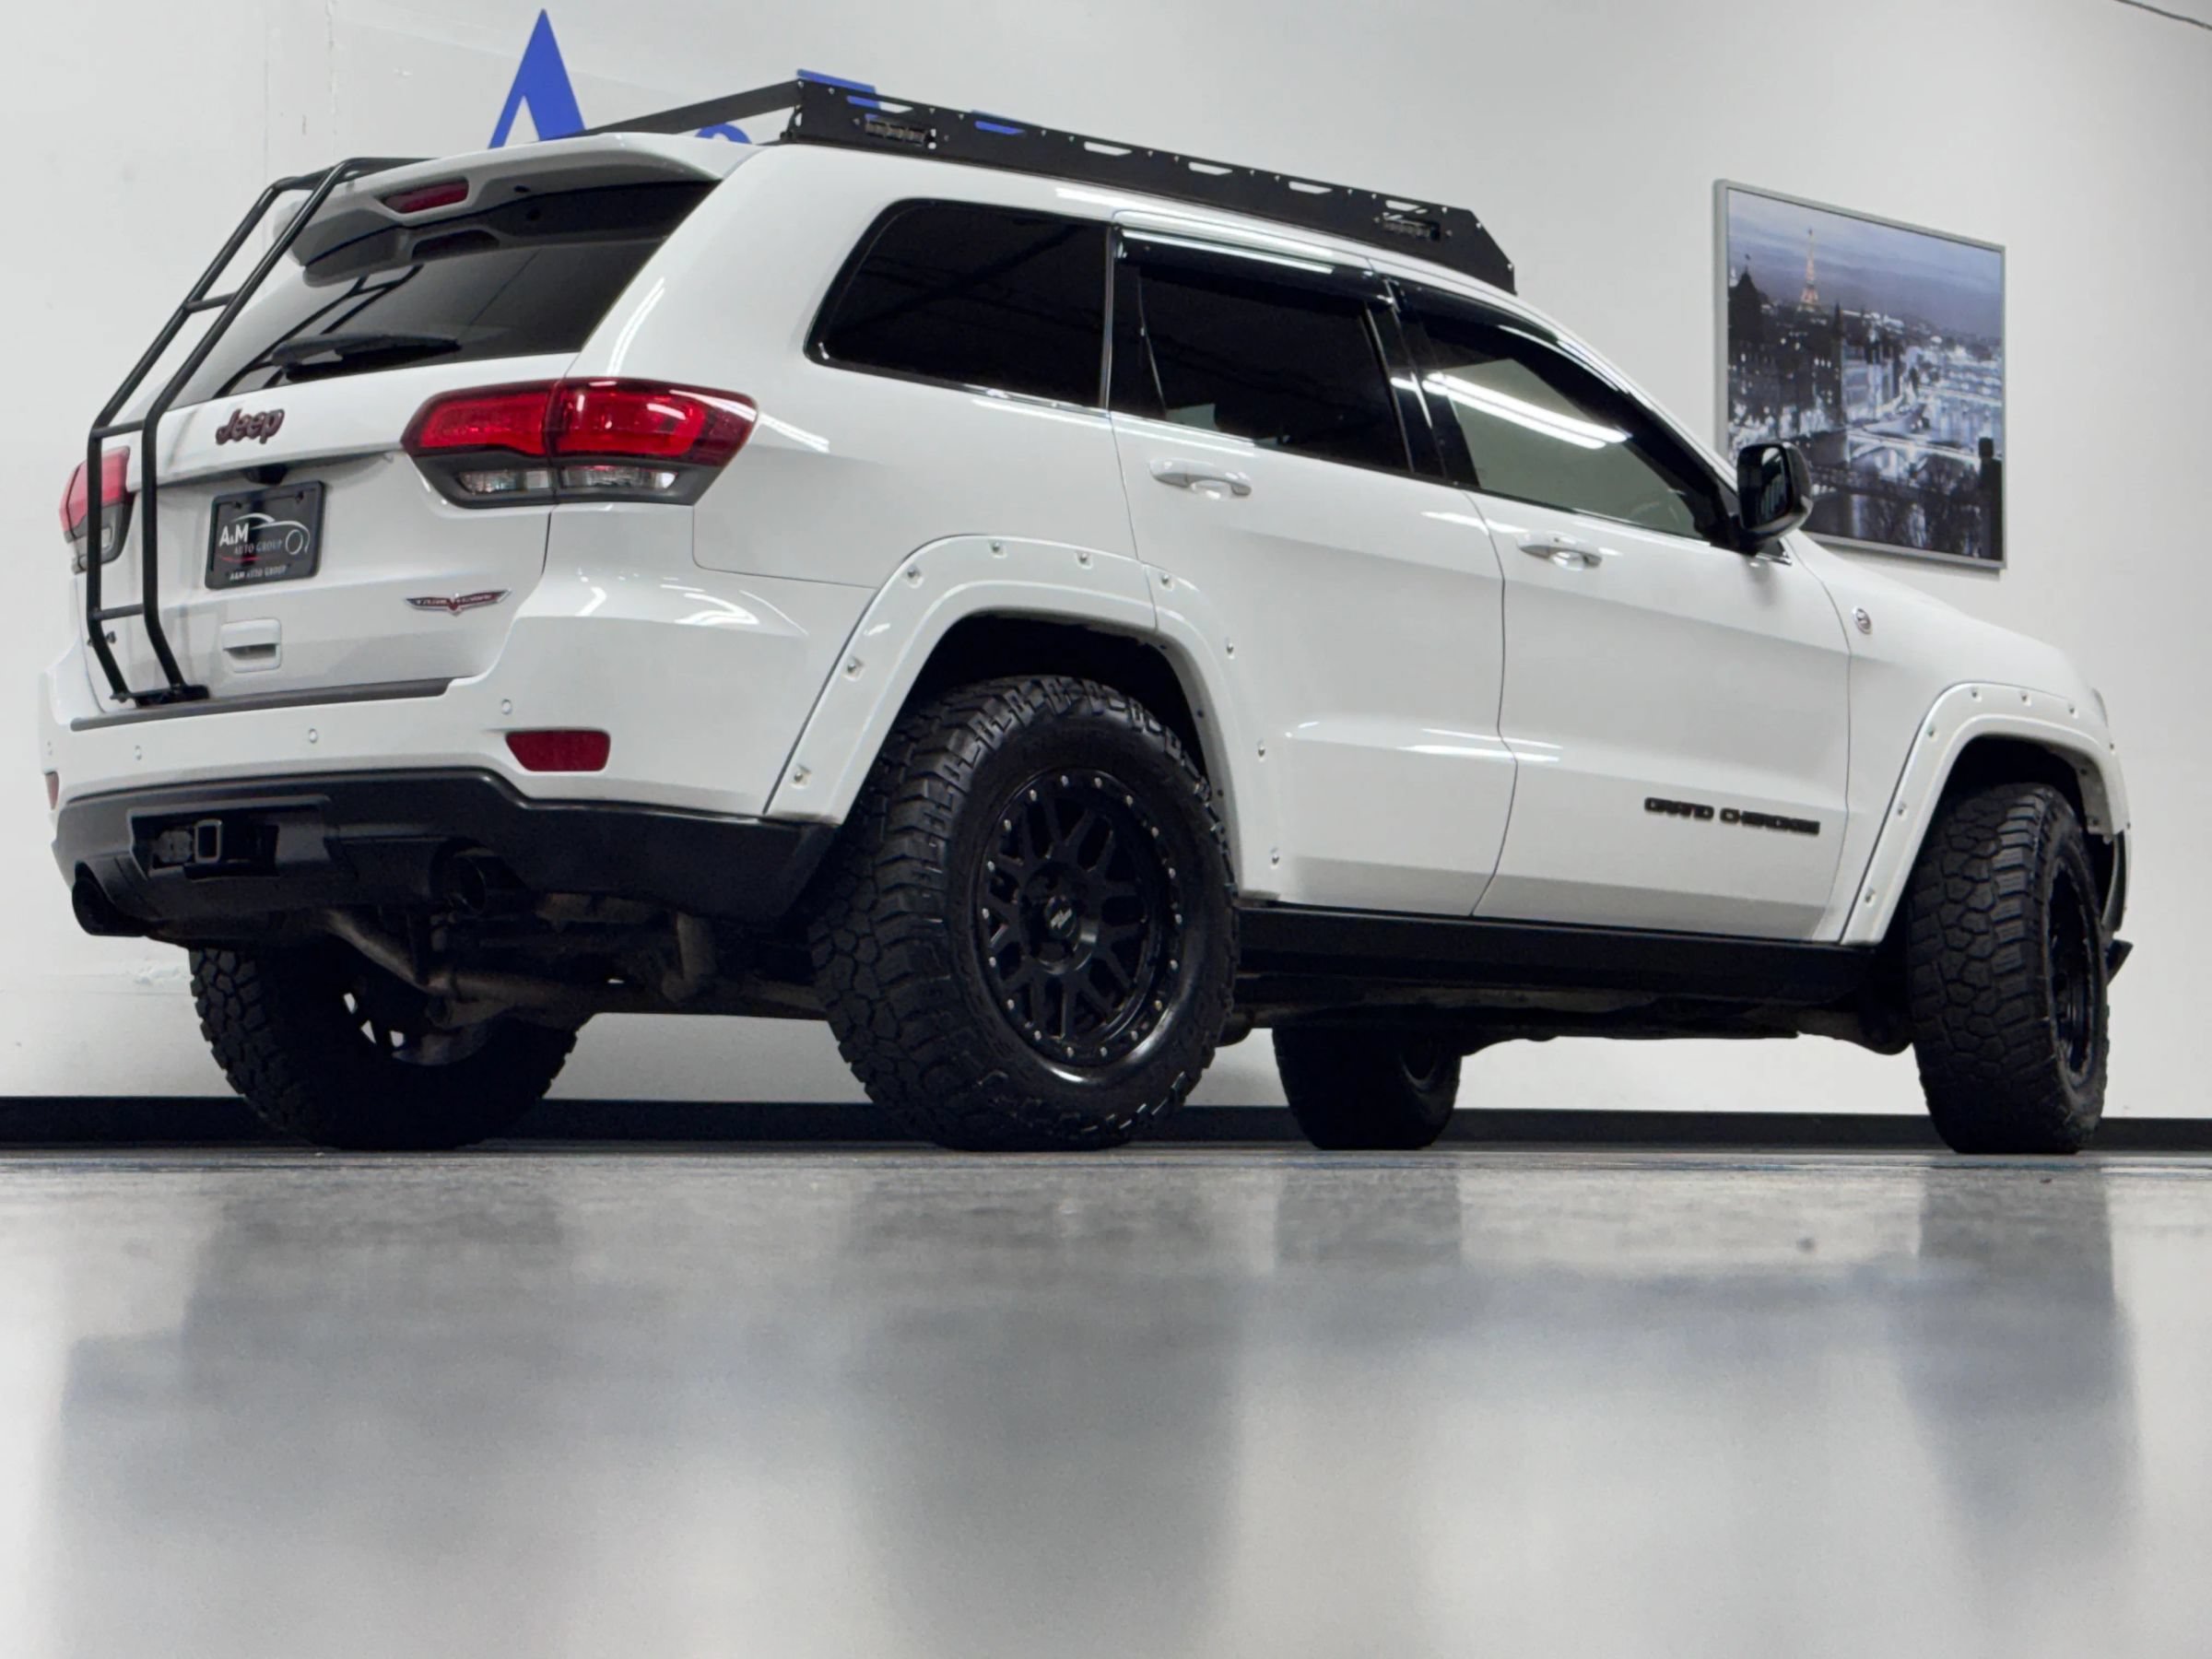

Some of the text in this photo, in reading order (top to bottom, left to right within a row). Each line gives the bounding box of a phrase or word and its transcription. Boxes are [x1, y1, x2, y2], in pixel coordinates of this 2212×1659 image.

[215, 407, 285, 446] Jeep
[234, 539, 282, 555] AUTO GROUP
